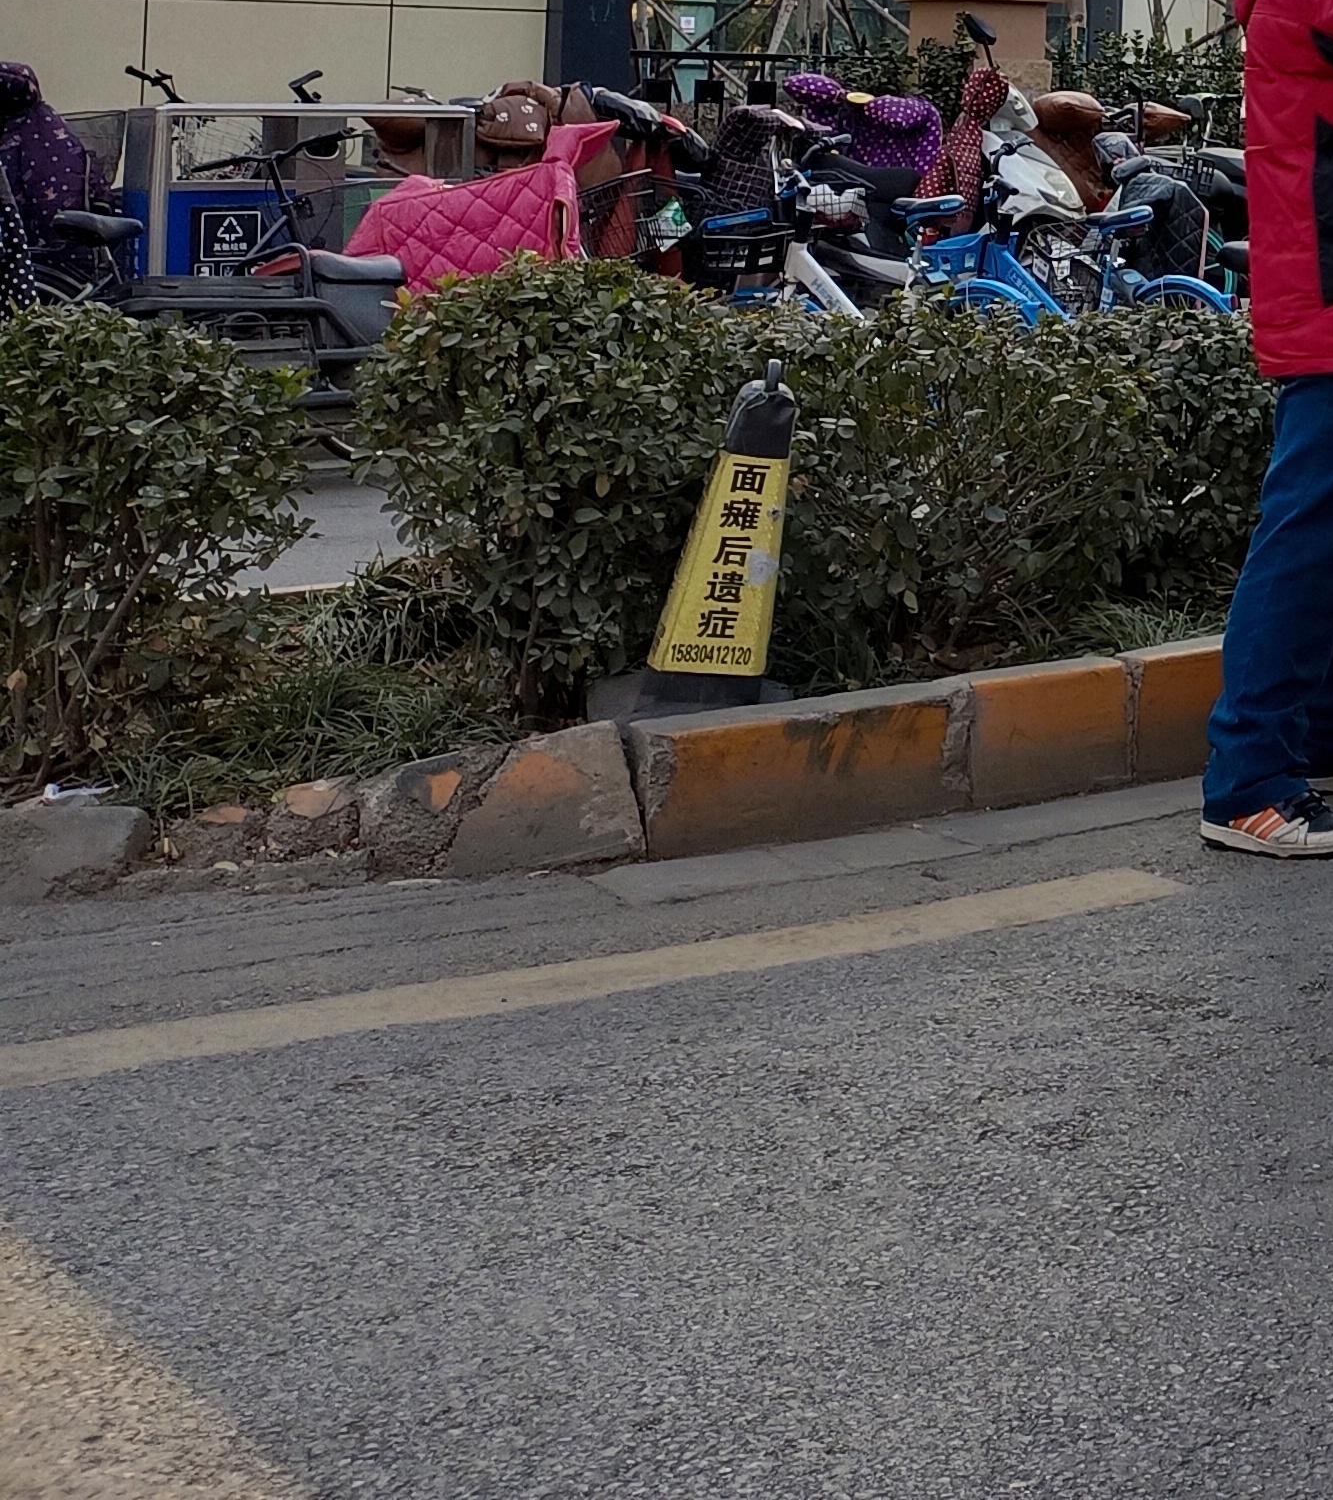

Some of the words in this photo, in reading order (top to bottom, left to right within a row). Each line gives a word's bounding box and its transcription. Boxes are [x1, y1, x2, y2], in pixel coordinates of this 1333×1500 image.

[697, 462, 771, 639] 面瘫后遗症
[670, 643, 752, 666] 15830412120
